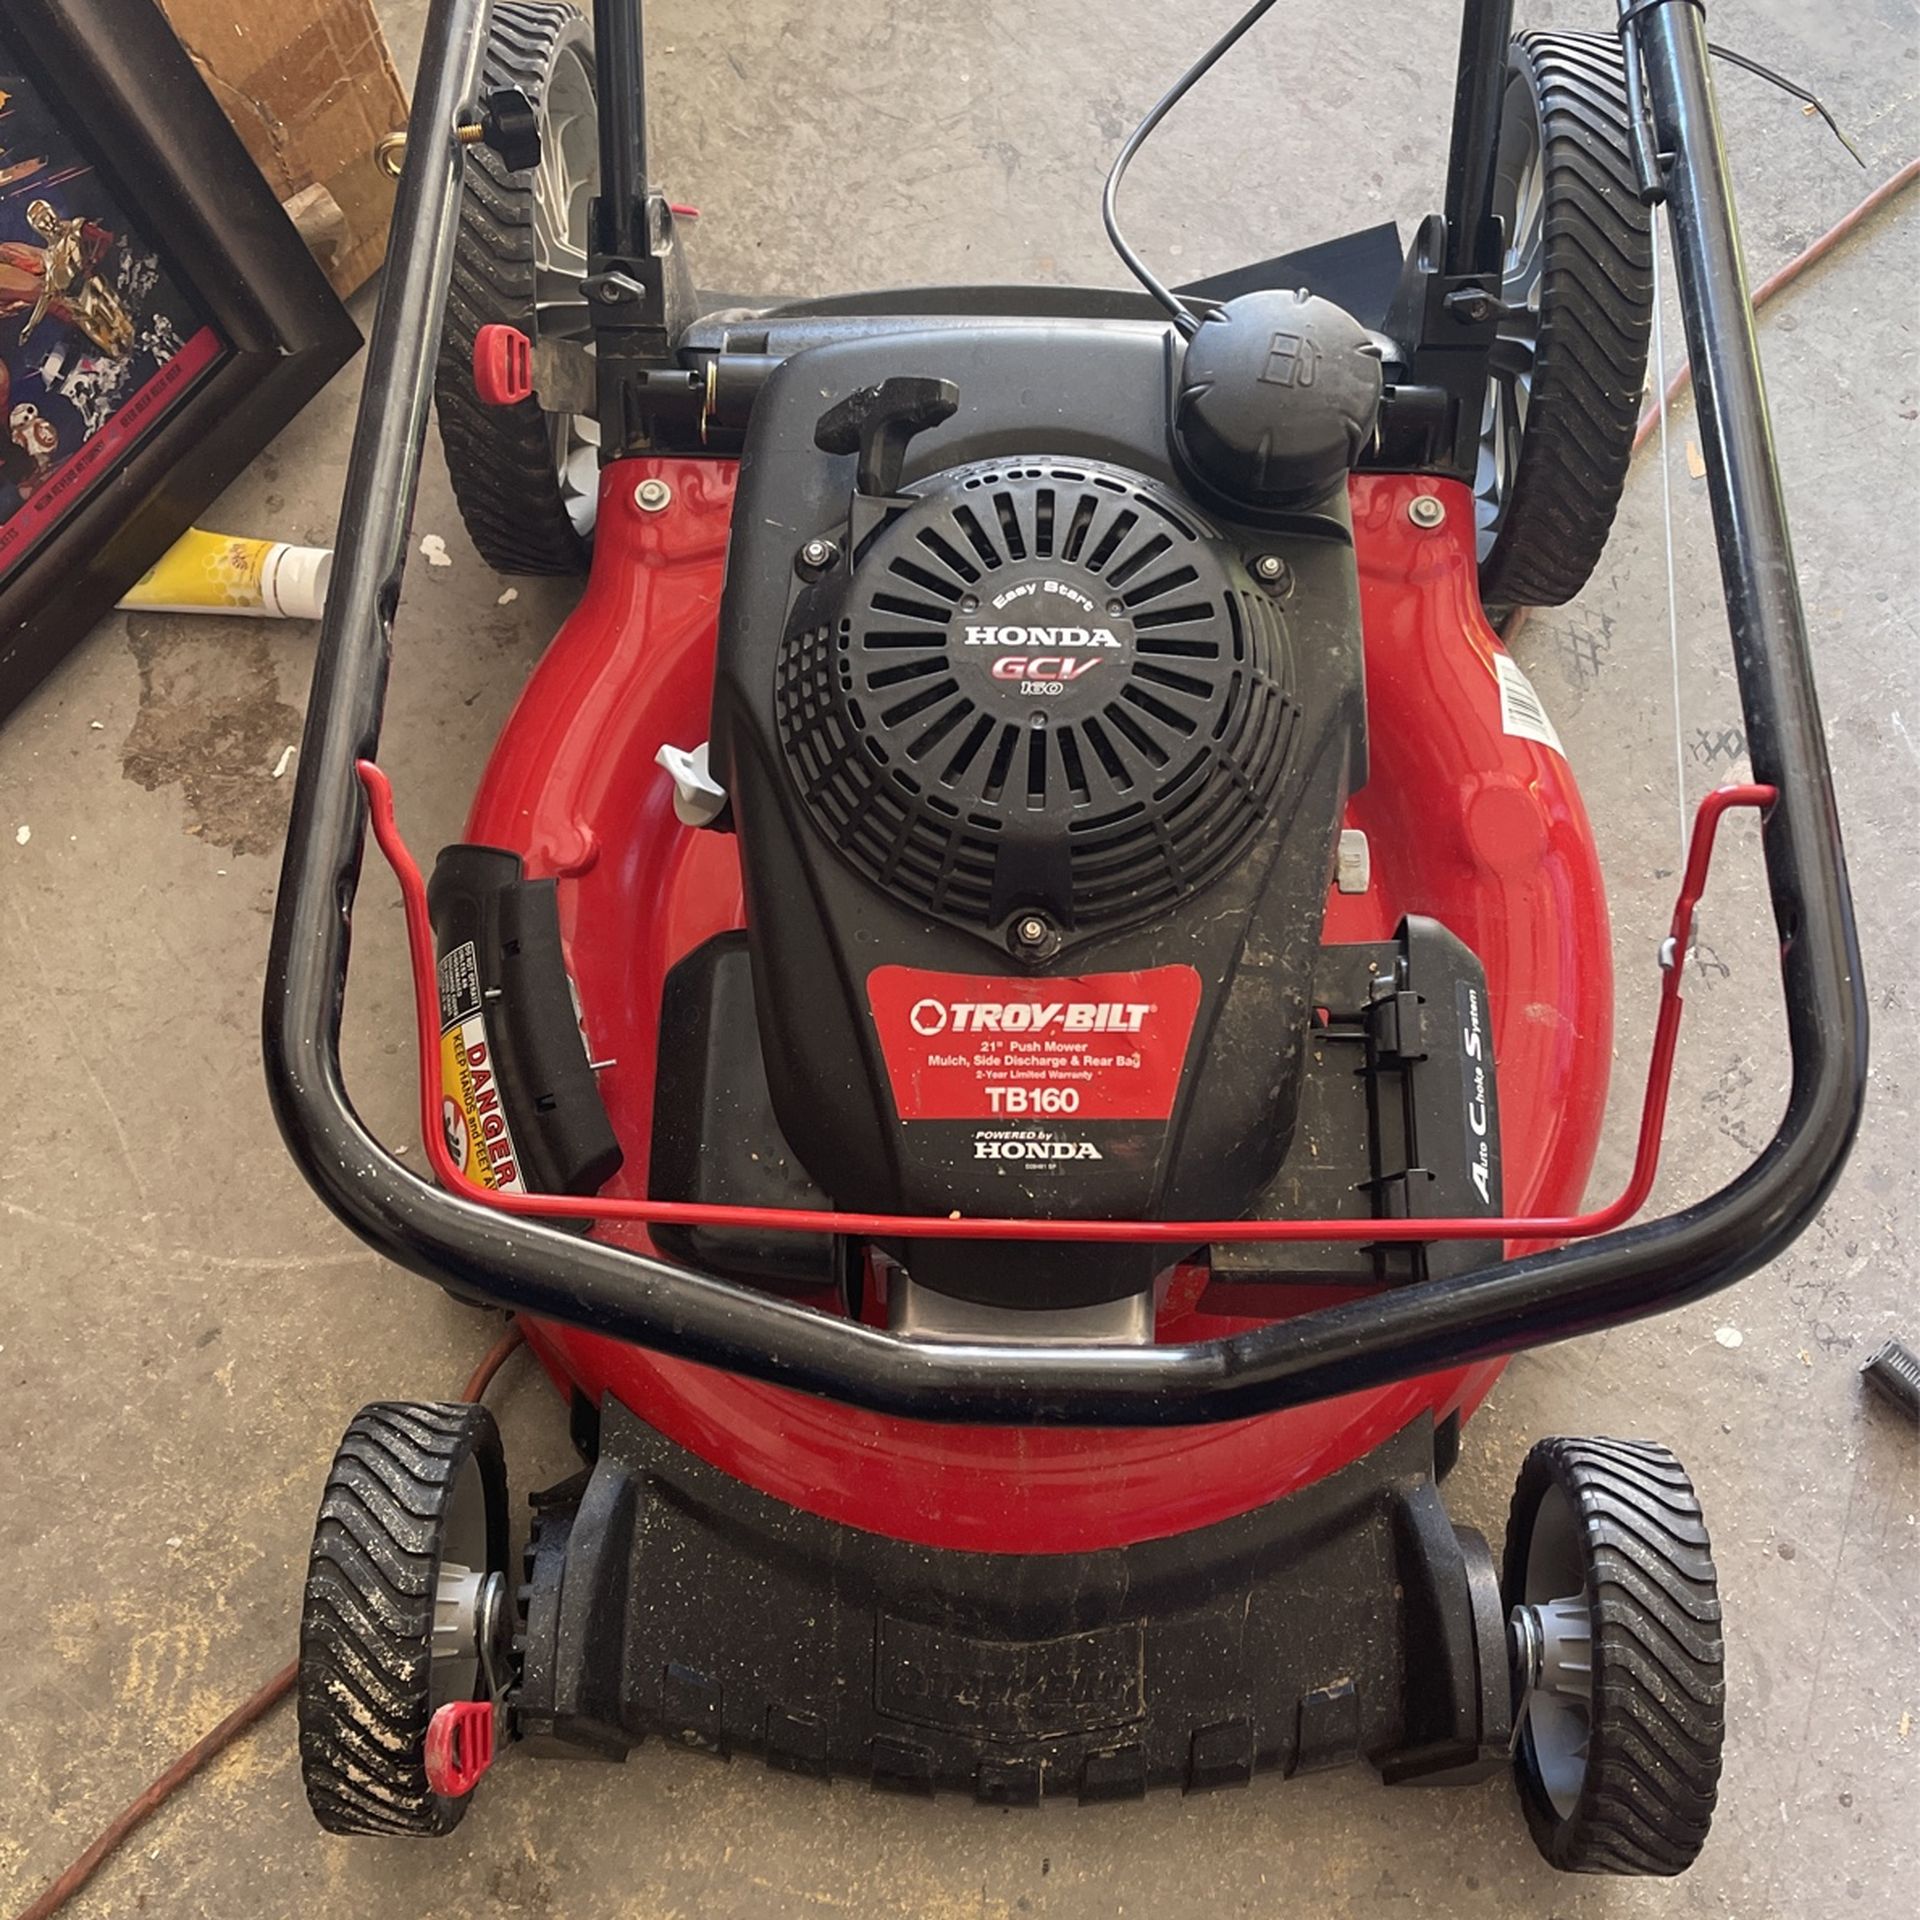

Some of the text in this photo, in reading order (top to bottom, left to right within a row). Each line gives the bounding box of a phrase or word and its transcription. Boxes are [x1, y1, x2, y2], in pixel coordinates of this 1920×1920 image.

[992, 581, 1094, 612] Easy Start
[964, 626, 1122, 648] HONDA
[991, 656, 1103, 680] GCV
[1020, 681, 1063, 695] 160
[950, 1003, 1150, 1032] TROY-BILT
[453, 1032, 467, 1067] KEEP
[981, 1041, 1088, 1052] 21" Push Mower
[928, 1055, 1141, 1069] Mulch, Side Discharge & Rear Bag
[975, 1070, 1093, 1081] 2-Year Limited Warranty
[459, 1070, 476, 1114] HANDS
[985, 1087, 1080, 1113] TB160
[1464, 989, 1490, 1204] Auto Choke System
[467, 1042, 516, 1188] DANGER
[468, 1116, 482, 1140] and
[976, 1131, 1053, 1141] POWERED by
[474, 1140, 491, 1173] FEET
[973, 1141, 1103, 1159] HONDA
